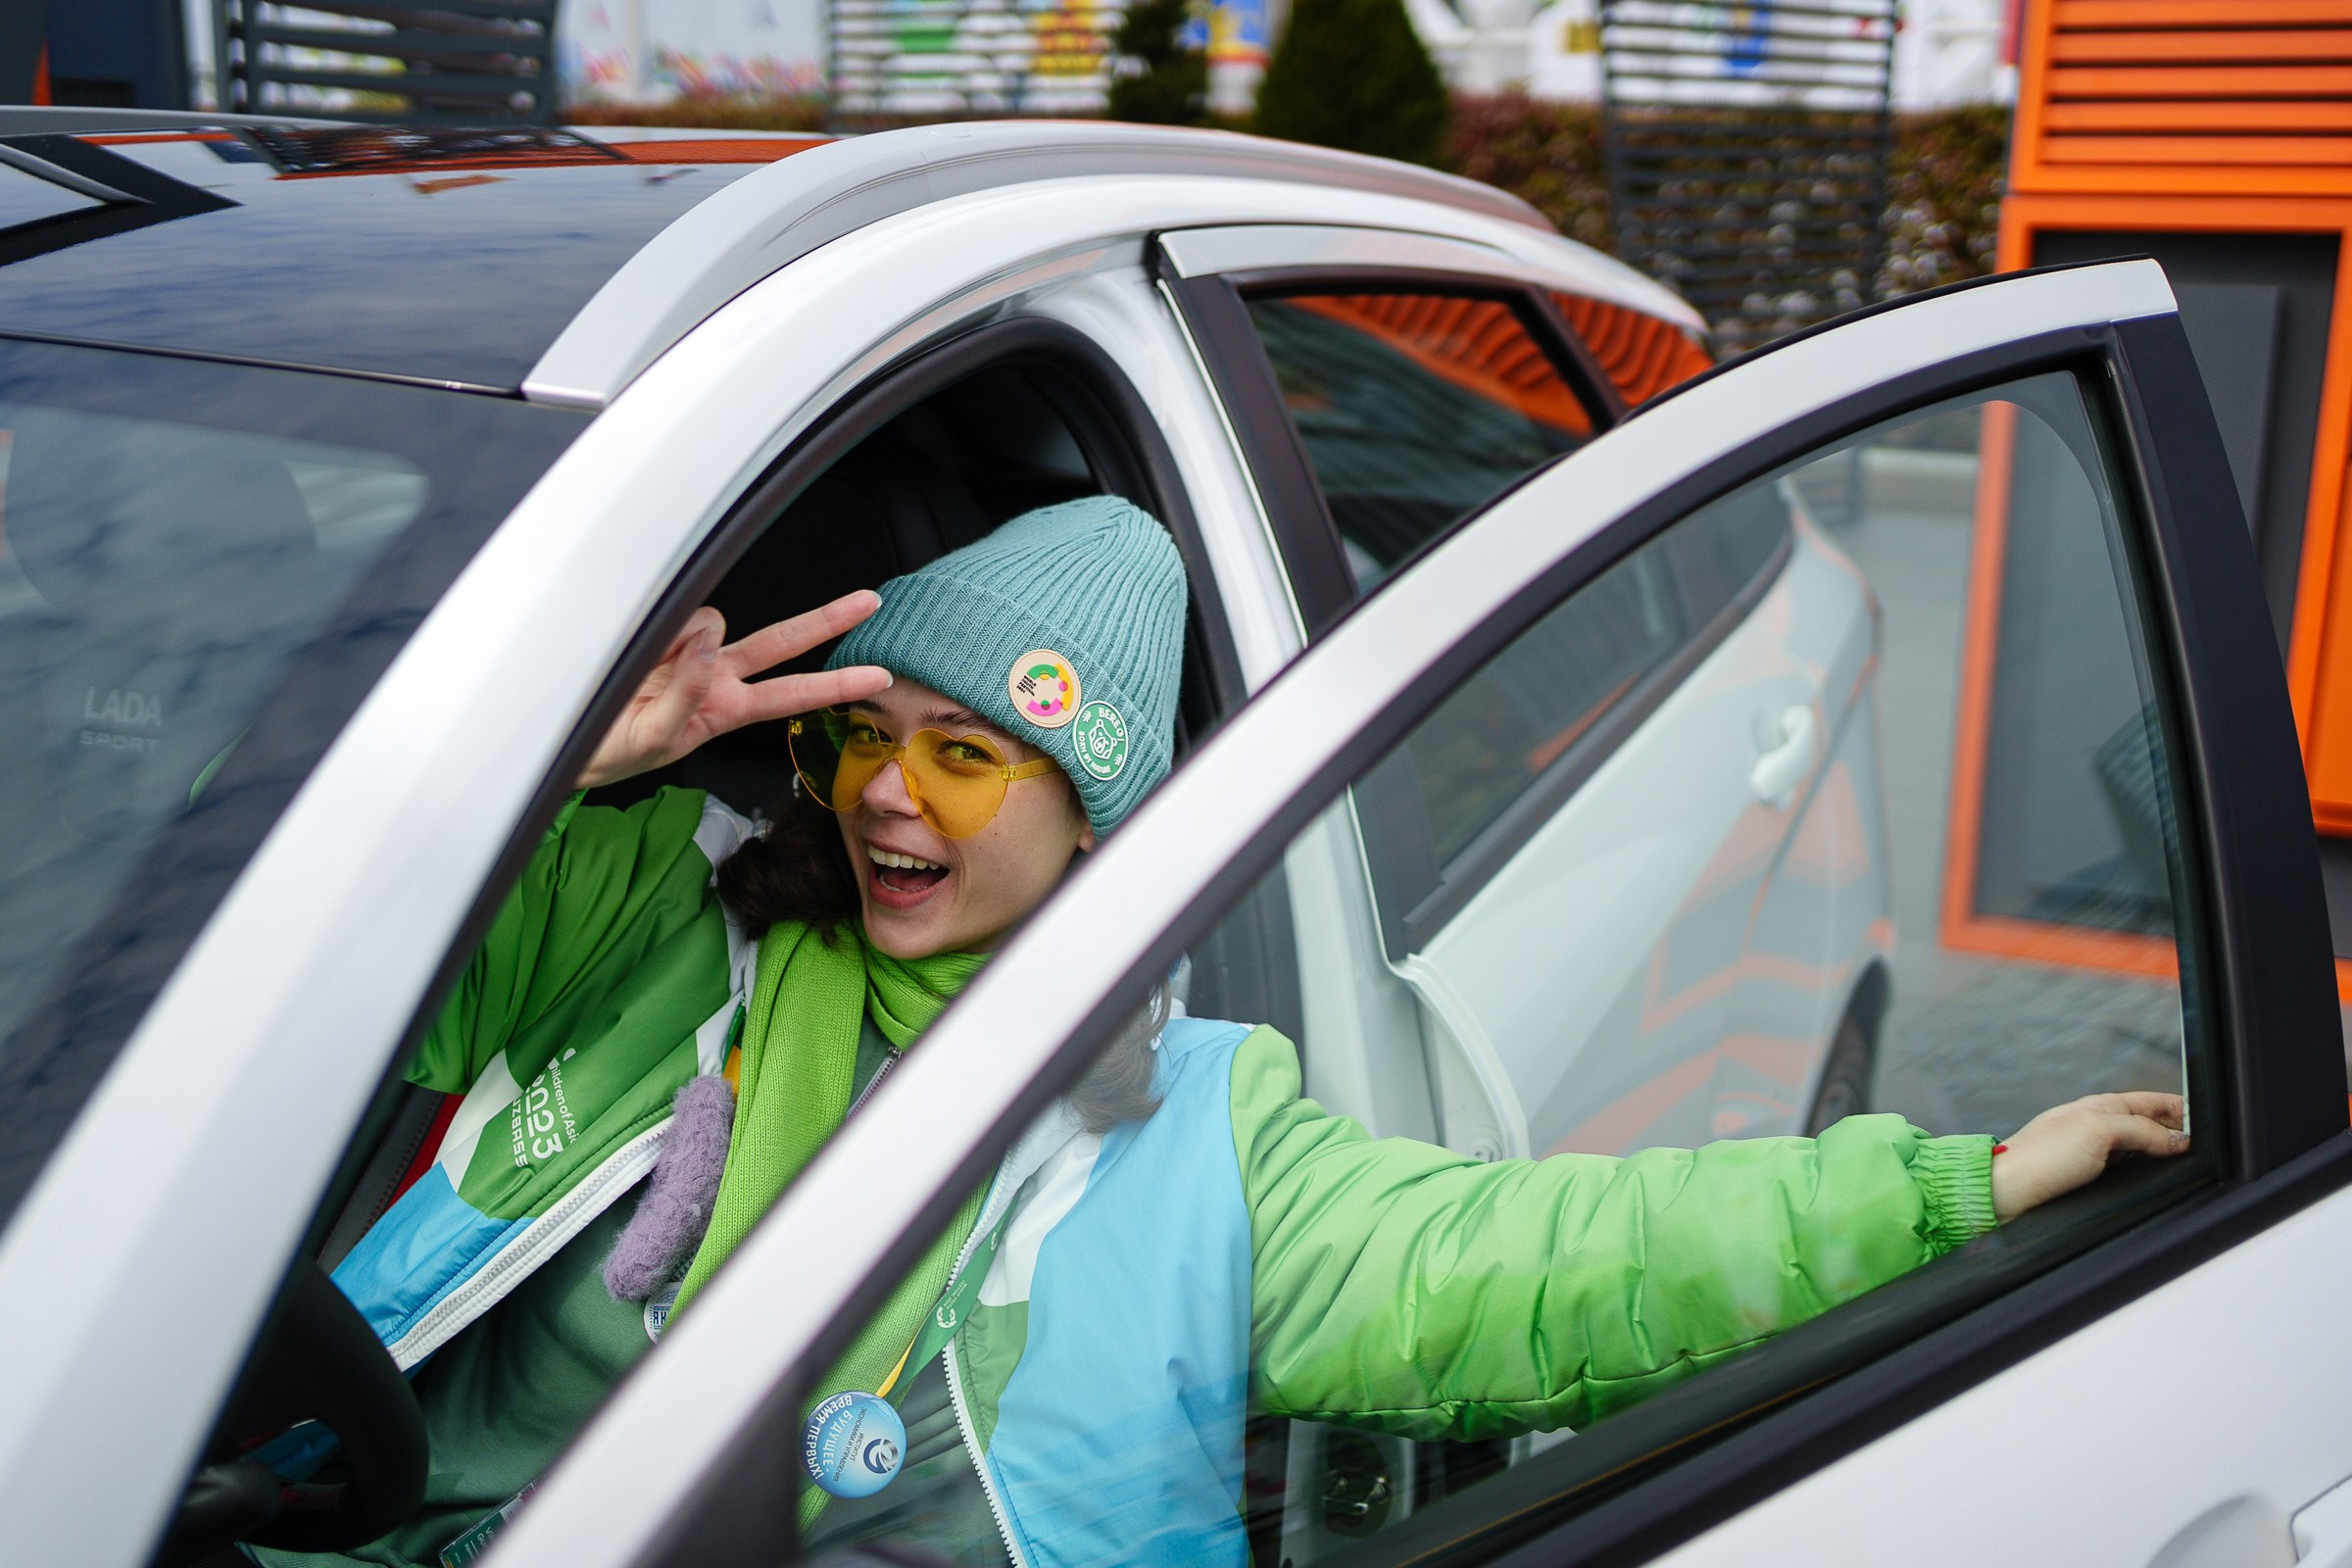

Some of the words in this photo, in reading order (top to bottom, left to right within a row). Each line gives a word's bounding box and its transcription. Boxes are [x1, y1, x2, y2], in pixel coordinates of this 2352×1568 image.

[84, 687, 162, 726] LADA
[1099, 707, 1125, 742] BEREGI
[79, 729, 160, 753] SPORT
[1078, 730, 1087, 754] BORN
[1083, 753, 1093, 763] BY
[1090, 761, 1111, 774] NATURE
[550, 1065, 566, 1105] hildren
[559, 1104, 573, 1121] of
[815, 1395, 853, 1425] ВРЕМЯ
[850, 1406, 867, 1439] ЭКОНОМИКИ
[806, 1425, 825, 1480] ПЕРВЫХ!
[833, 1446, 852, 1483] УПРАВЛЕНИЯ
[849, 1433, 865, 1462] ИНСТИТУТ
